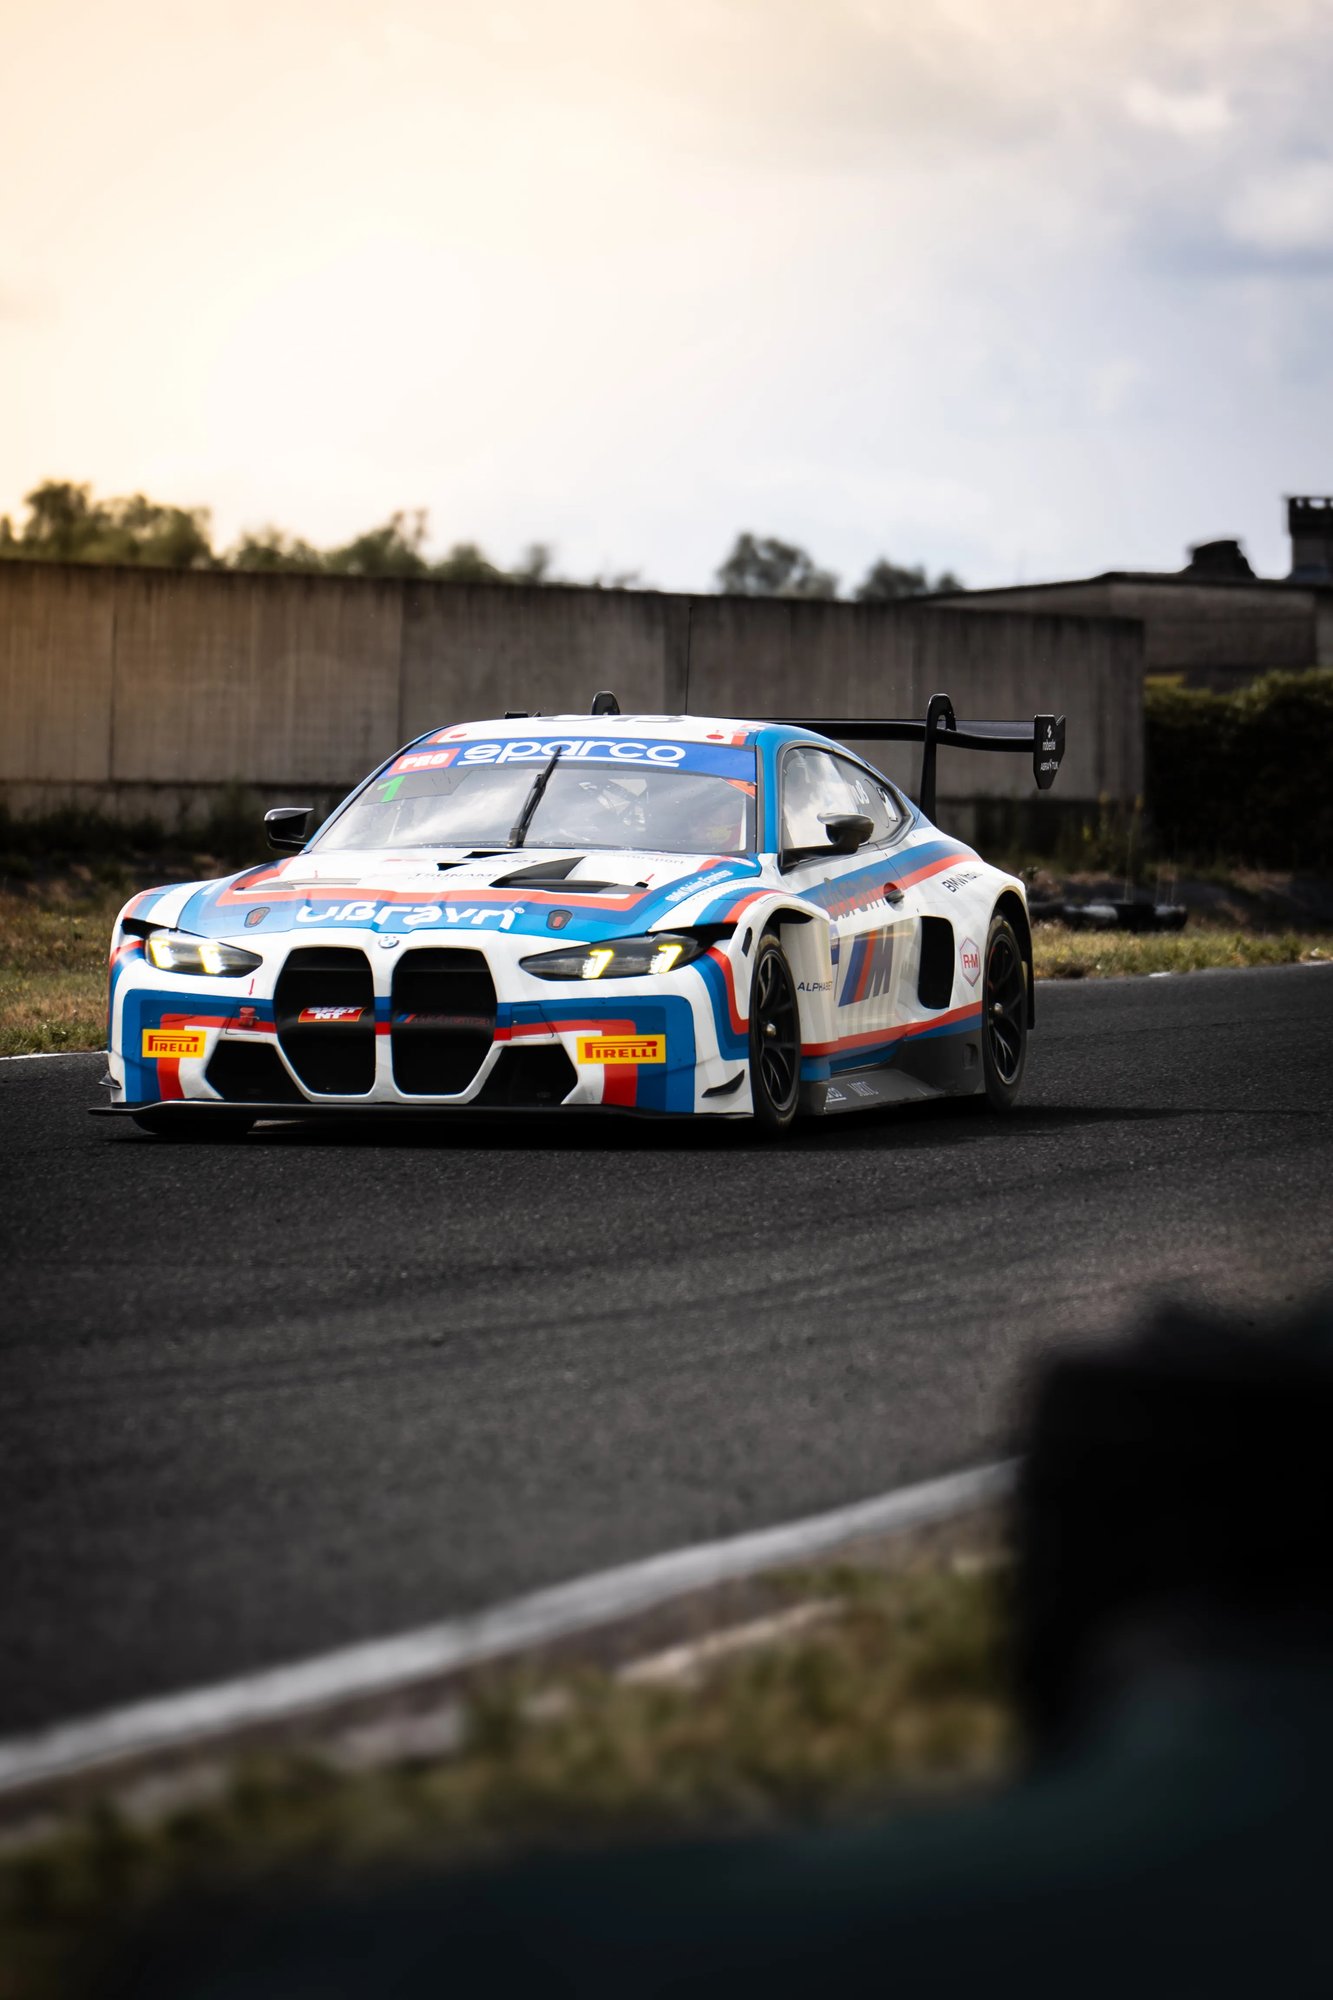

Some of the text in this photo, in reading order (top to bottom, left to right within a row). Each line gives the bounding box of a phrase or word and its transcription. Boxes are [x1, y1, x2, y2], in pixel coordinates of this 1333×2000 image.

[402, 752, 450, 770] PRO
[463, 739, 687, 765] sparco
[376, 775, 406, 802] 1
[963, 953, 979, 969] R-M
[148, 1034, 199, 1053] PIRELLI
[584, 1041, 658, 1060] PIRELLI
